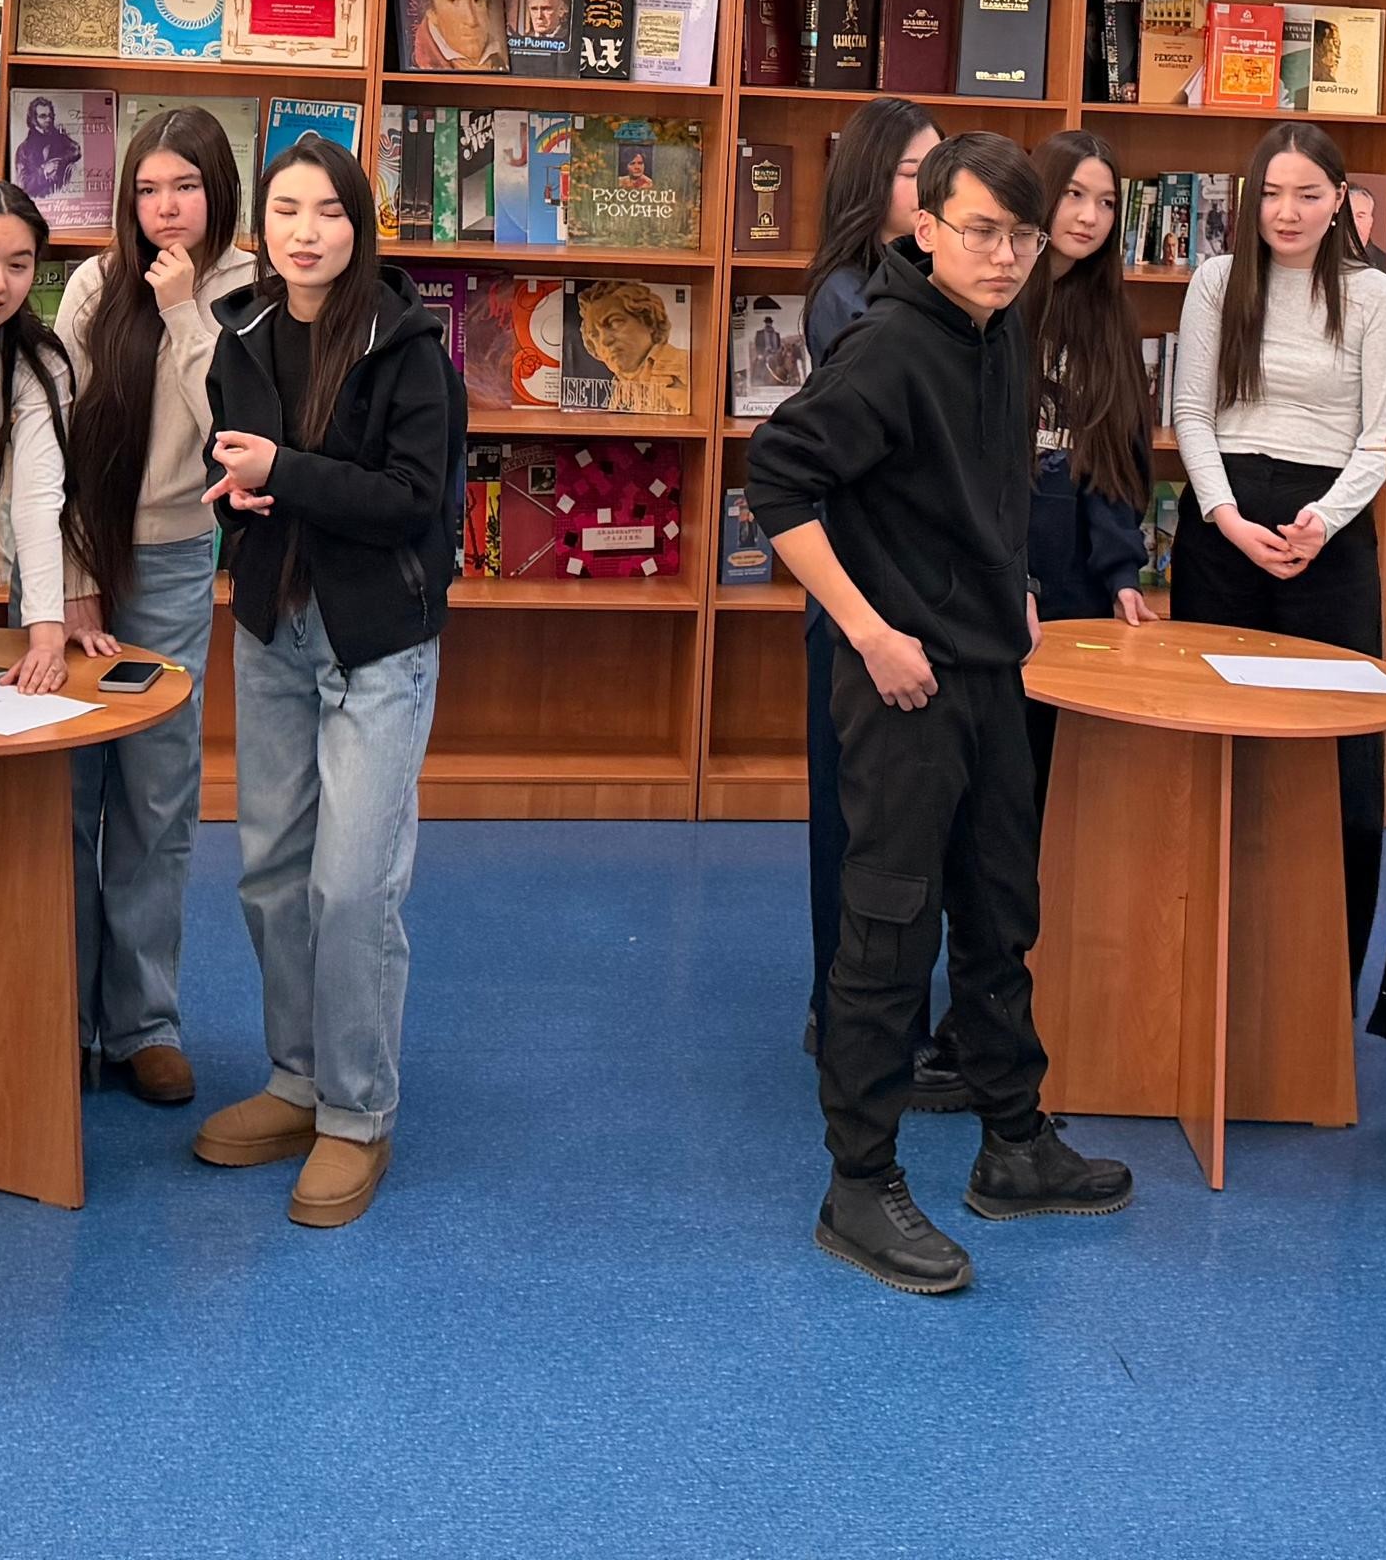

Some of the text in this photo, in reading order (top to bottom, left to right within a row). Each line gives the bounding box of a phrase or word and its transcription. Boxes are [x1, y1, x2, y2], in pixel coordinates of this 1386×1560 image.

[295, 102, 341, 119] МОЦАРТ
[593, 188, 676, 203] РУССКИЙ
[596, 203, 673, 218] РОМАНС
[417, 282, 454, 298] АМС
